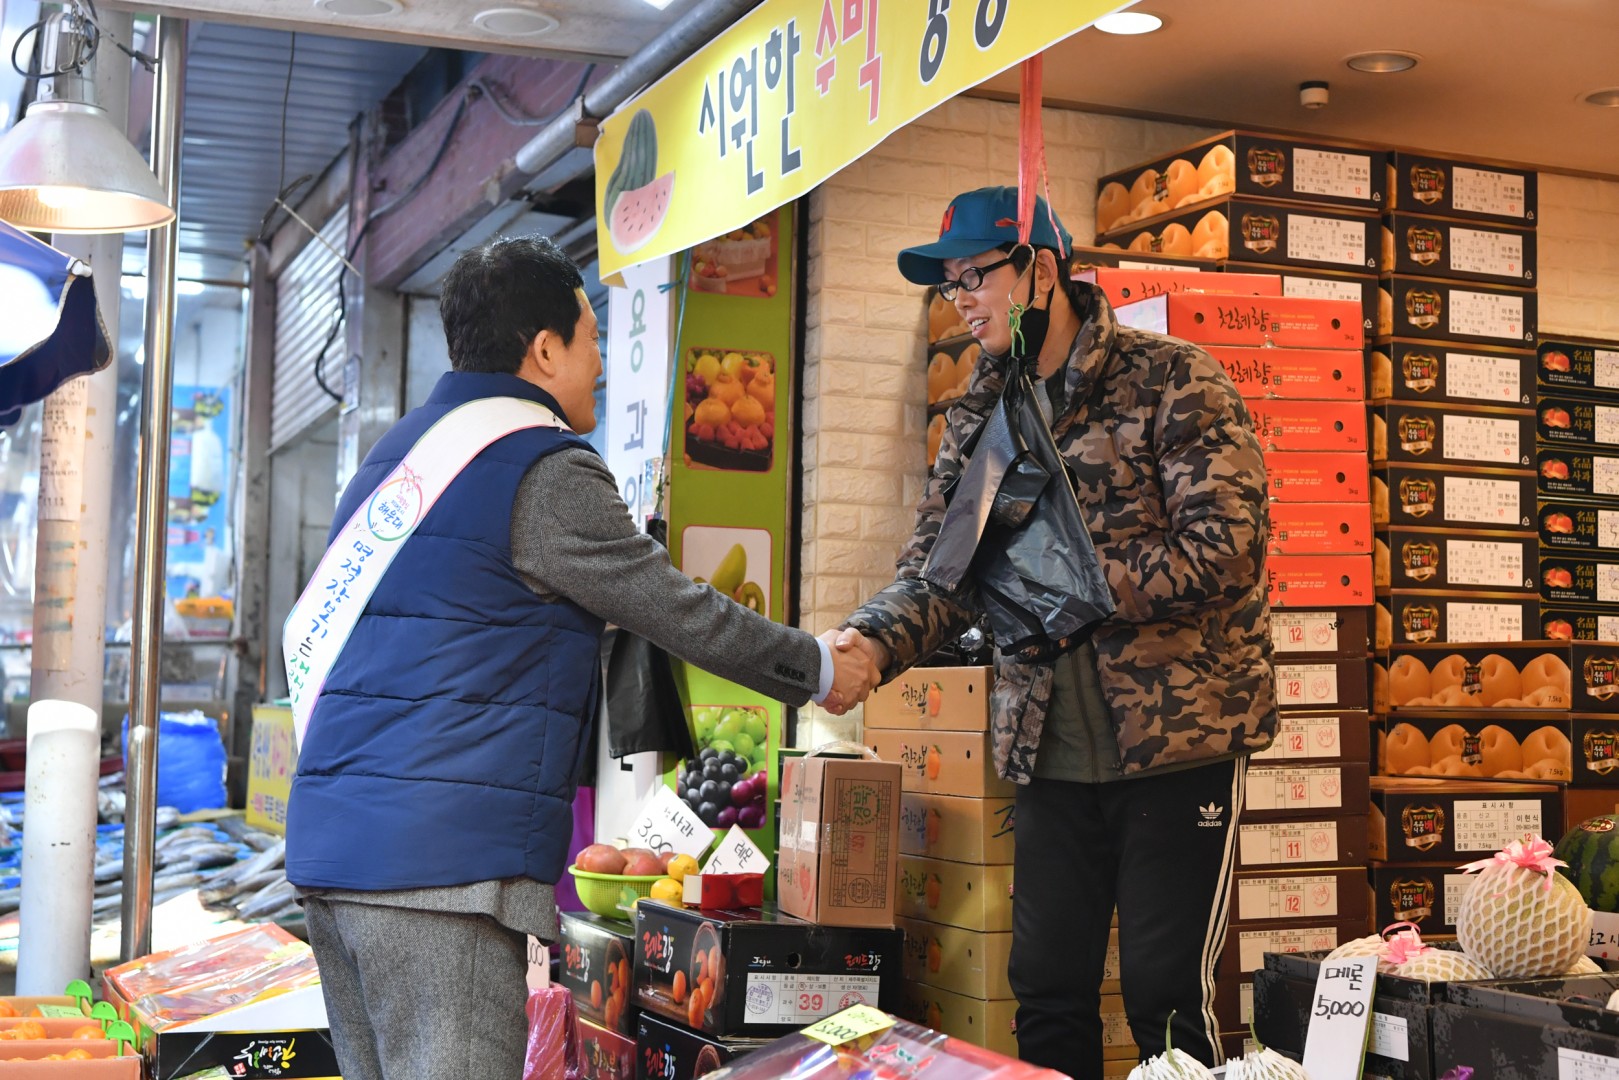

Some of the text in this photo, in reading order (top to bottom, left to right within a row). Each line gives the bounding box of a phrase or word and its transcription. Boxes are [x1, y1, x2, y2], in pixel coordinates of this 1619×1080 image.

[699, 19, 801, 195] 시원한
[815, 0, 881, 124] 수박
[1355, 187, 1361, 195] 12
[939, 205, 955, 238] N
[1217, 306, 1270, 332] 천혜향
[1574, 364, 1592, 375] 사과
[1574, 420, 1592, 431] 사과
[1572, 471, 1591, 482] 사과
[378, 501, 404, 530] 해운대
[1576, 524, 1595, 536] 사과
[1575, 578, 1594, 590] 사과
[1289, 626, 1303, 641] 12
[1288, 681, 1300, 695] 12
[902, 683, 929, 714] 한라봉
[1290, 735, 1302, 750] 12
[901, 745, 928, 776] 한라봉
[1293, 784, 1304, 798] 12
[901, 807, 927, 839] 한라봉
[1197, 820, 1223, 828] adidas
[1517, 814, 1539, 822] 이현식
[638, 818, 675, 855] 3,00
[1524, 833, 1531, 841] 12
[734, 840, 754, 869] 레몬
[1288, 842, 1300, 857] 11
[1287, 896, 1299, 911] 12
[643, 930, 675, 973] 레드향
[752, 956, 772, 967] Jeju
[844, 953, 881, 971] 레드향
[1325, 964, 1364, 991] 메론
[799, 994, 823, 1011] 39
[1315, 994, 1365, 1020] 5,000
[233, 1037, 297, 1069] 천혜향
